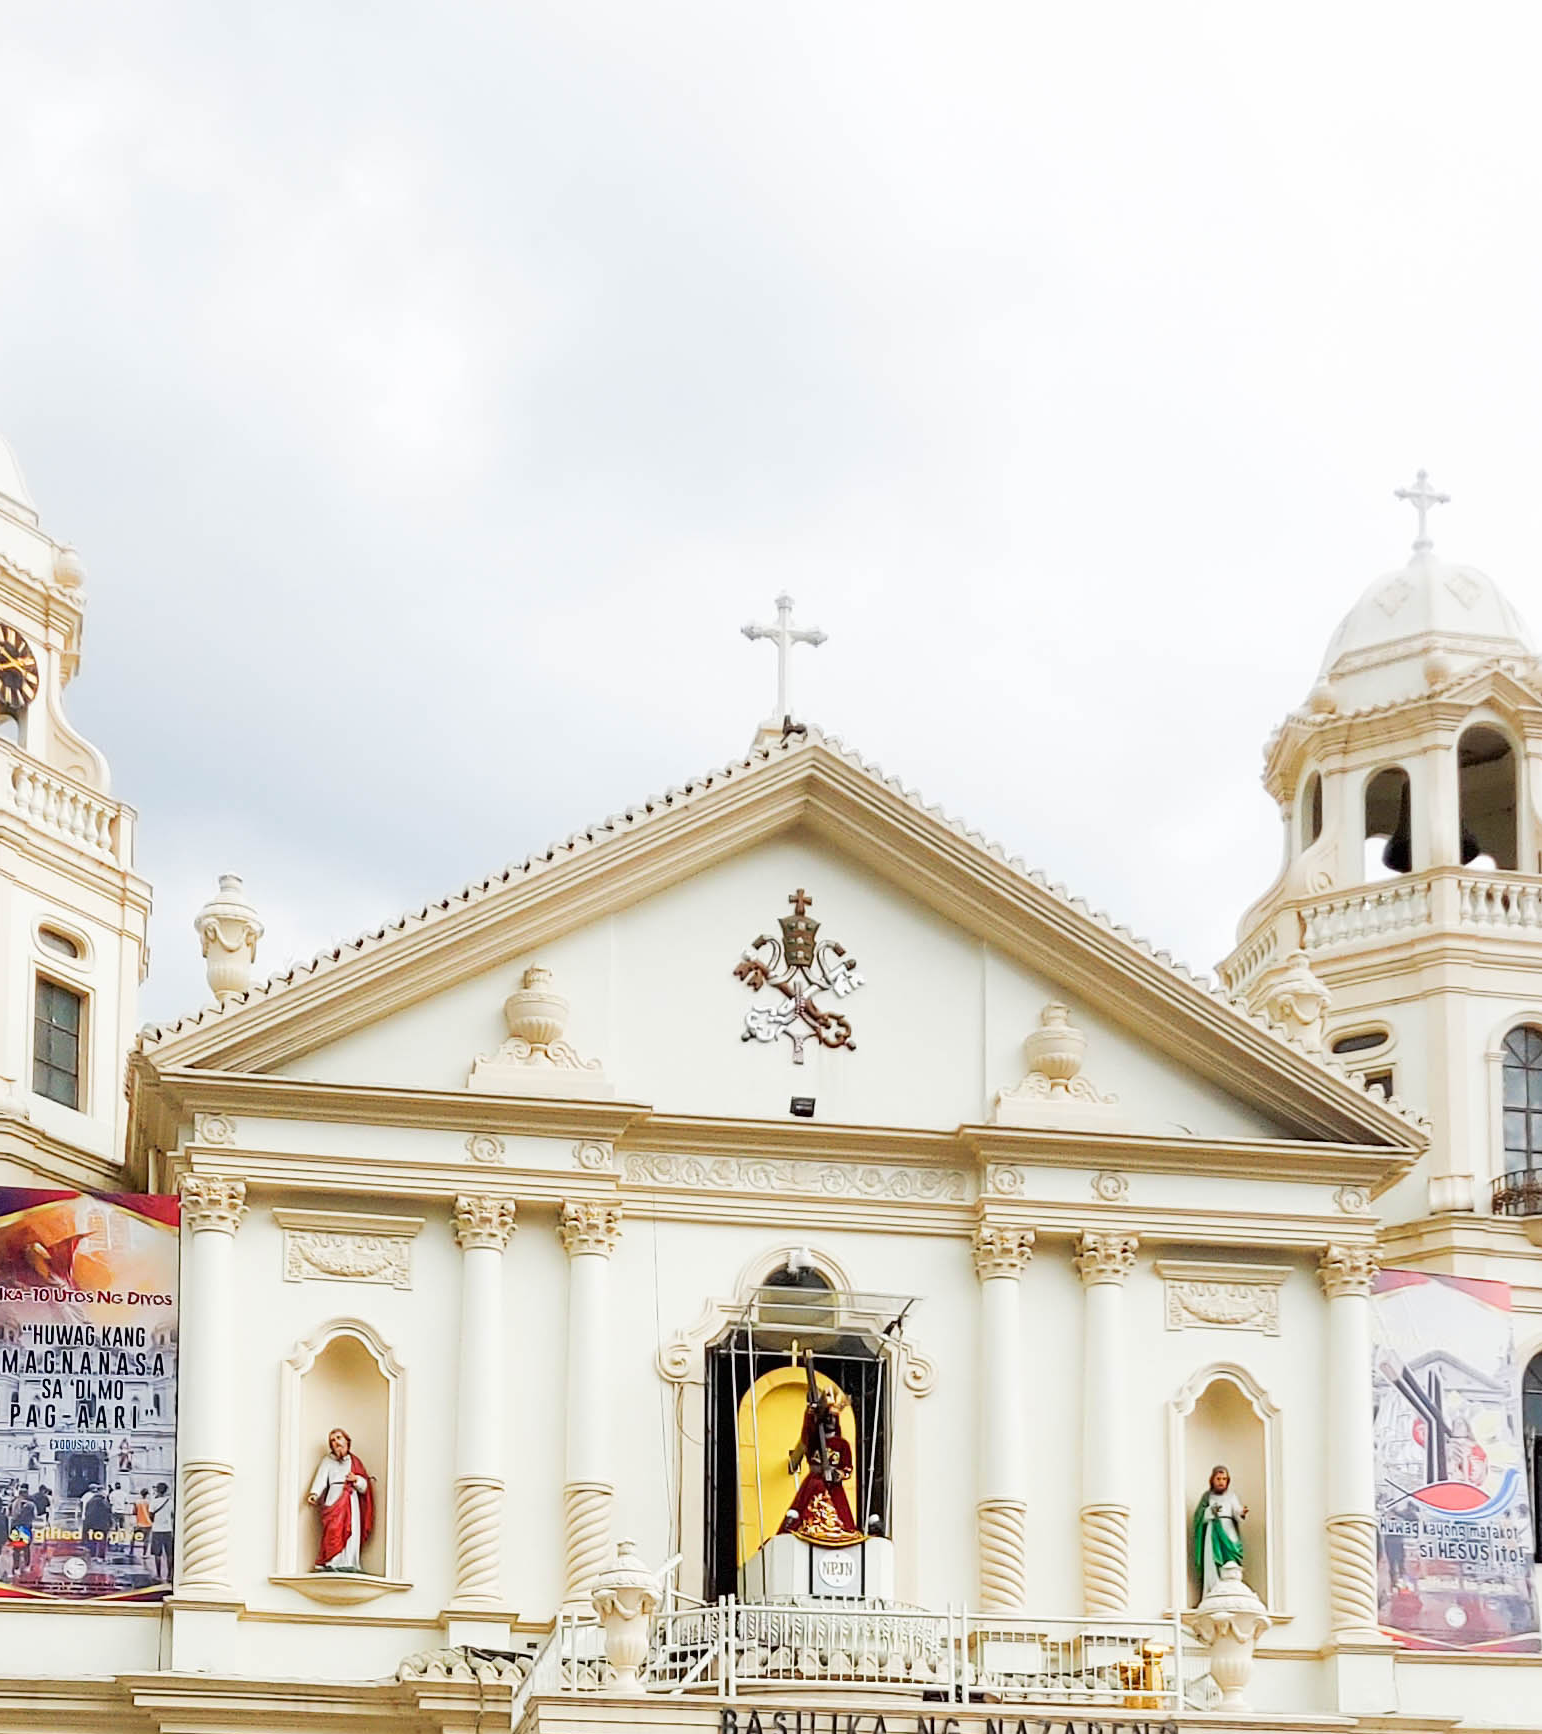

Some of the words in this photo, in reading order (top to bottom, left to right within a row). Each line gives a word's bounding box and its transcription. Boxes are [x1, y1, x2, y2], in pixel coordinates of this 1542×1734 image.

[101, 1326, 146, 1348] KANG
[1, 1349, 165, 1377] MAGNANASA
[41, 1378, 63, 1400] SA
[98, 1380, 124, 1401] MO
[49, 1438, 83, 1451] EXODUS
[33, 1526, 83, 1546] gifted
[87, 1527, 106, 1542] to
[1380, 1518, 1420, 1538] Huwag
[1423, 1521, 1466, 1542] kayong
[1470, 1525, 1519, 1540] matakot
[1420, 1543, 1434, 1558] si
[1438, 1542, 1490, 1561] HESUS
[1495, 1545, 1525, 1563] ito!
